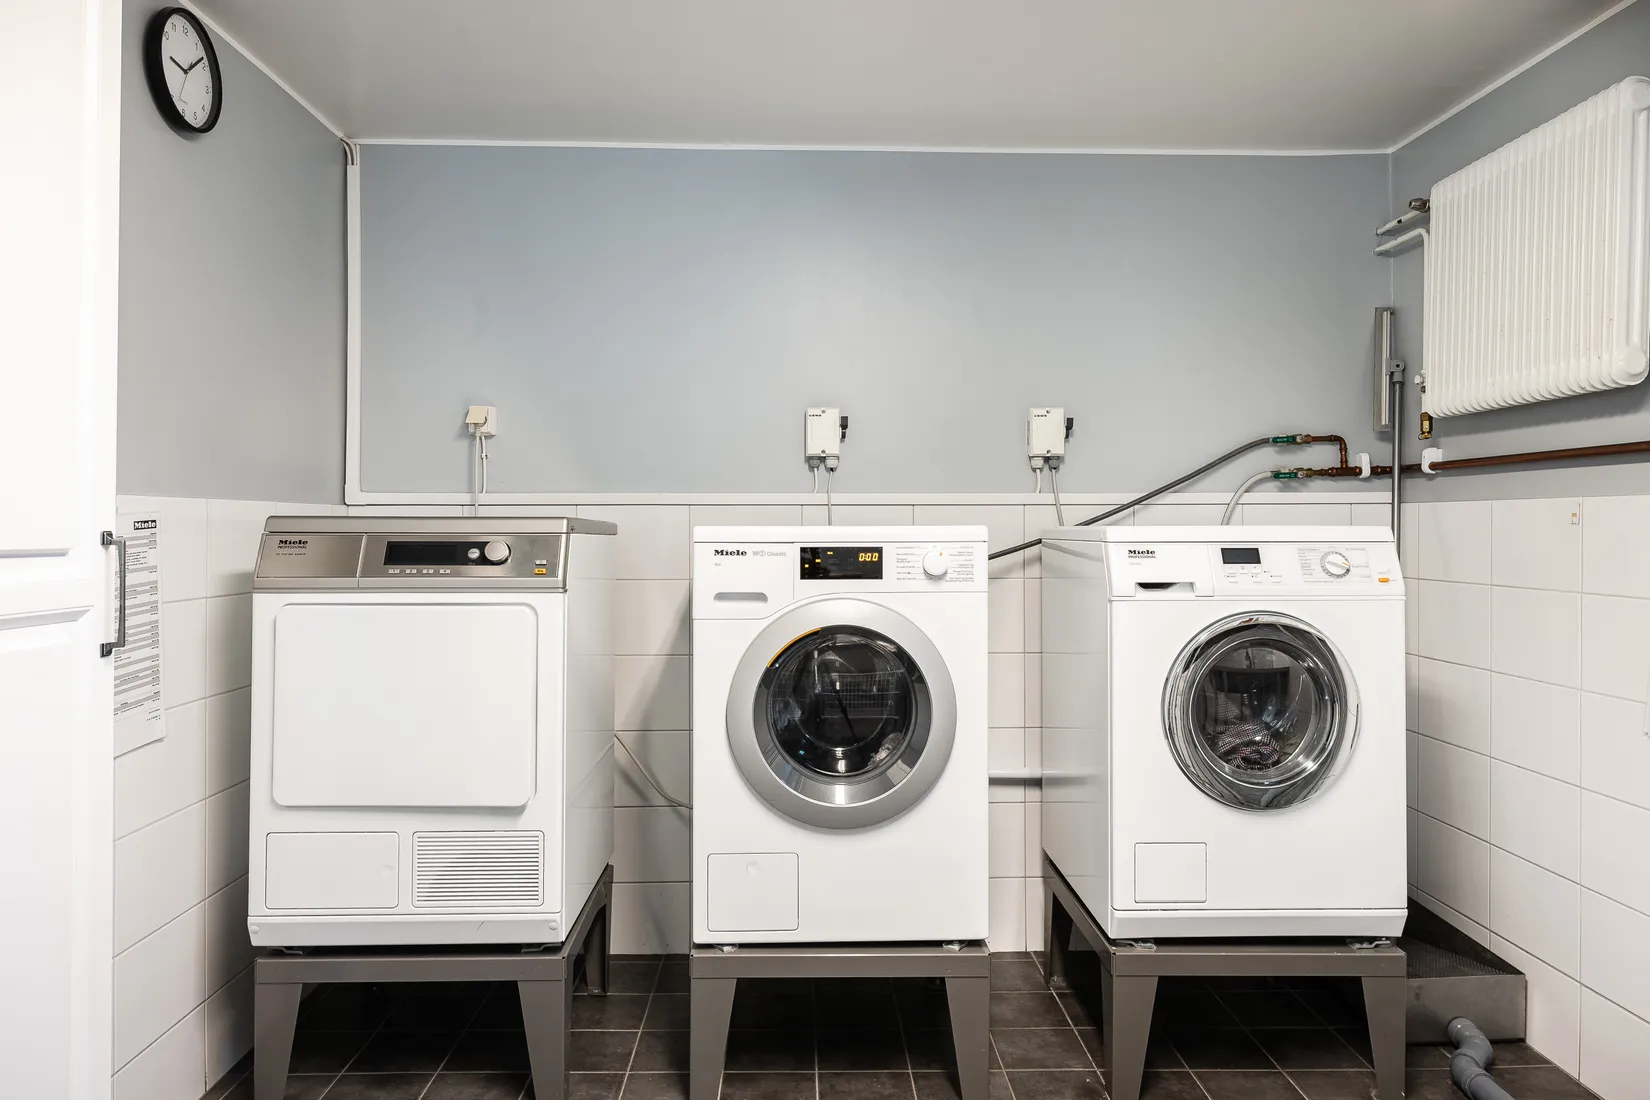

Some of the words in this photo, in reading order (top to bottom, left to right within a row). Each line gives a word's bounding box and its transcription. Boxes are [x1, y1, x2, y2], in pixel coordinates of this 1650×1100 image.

[182, 25, 189, 37] 12
[134, 521, 156, 530] Miele
[713, 549, 748, 557] Miele
[858, 552, 879, 562] 0:00
